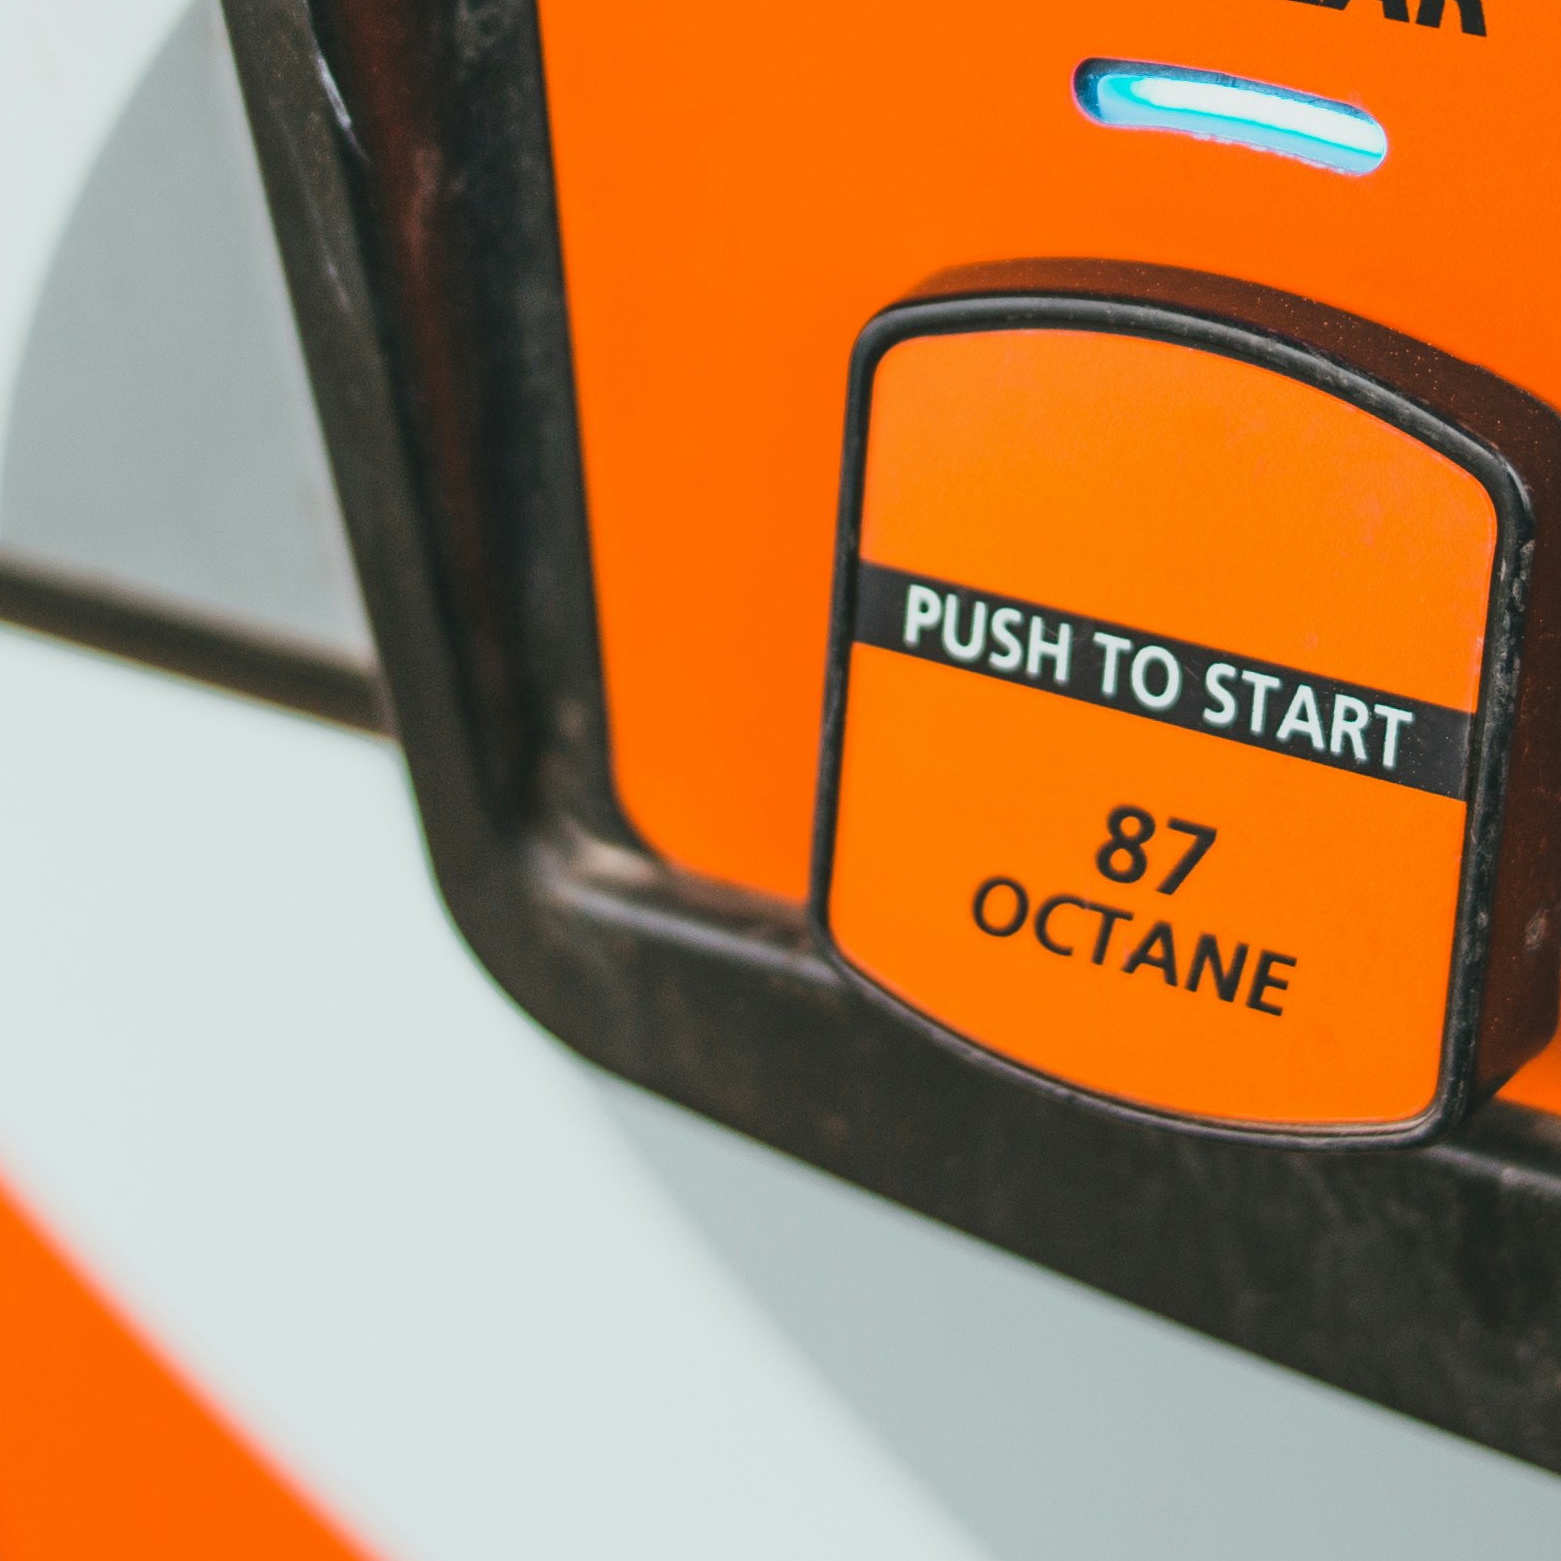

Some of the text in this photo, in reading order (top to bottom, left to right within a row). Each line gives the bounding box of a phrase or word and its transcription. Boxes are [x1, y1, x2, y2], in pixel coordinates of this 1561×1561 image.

[904, 584, 1413, 769] PUSH TO START
[1094, 804, 1218, 896] 87
[971, 875, 1298, 1017] OCTANE
